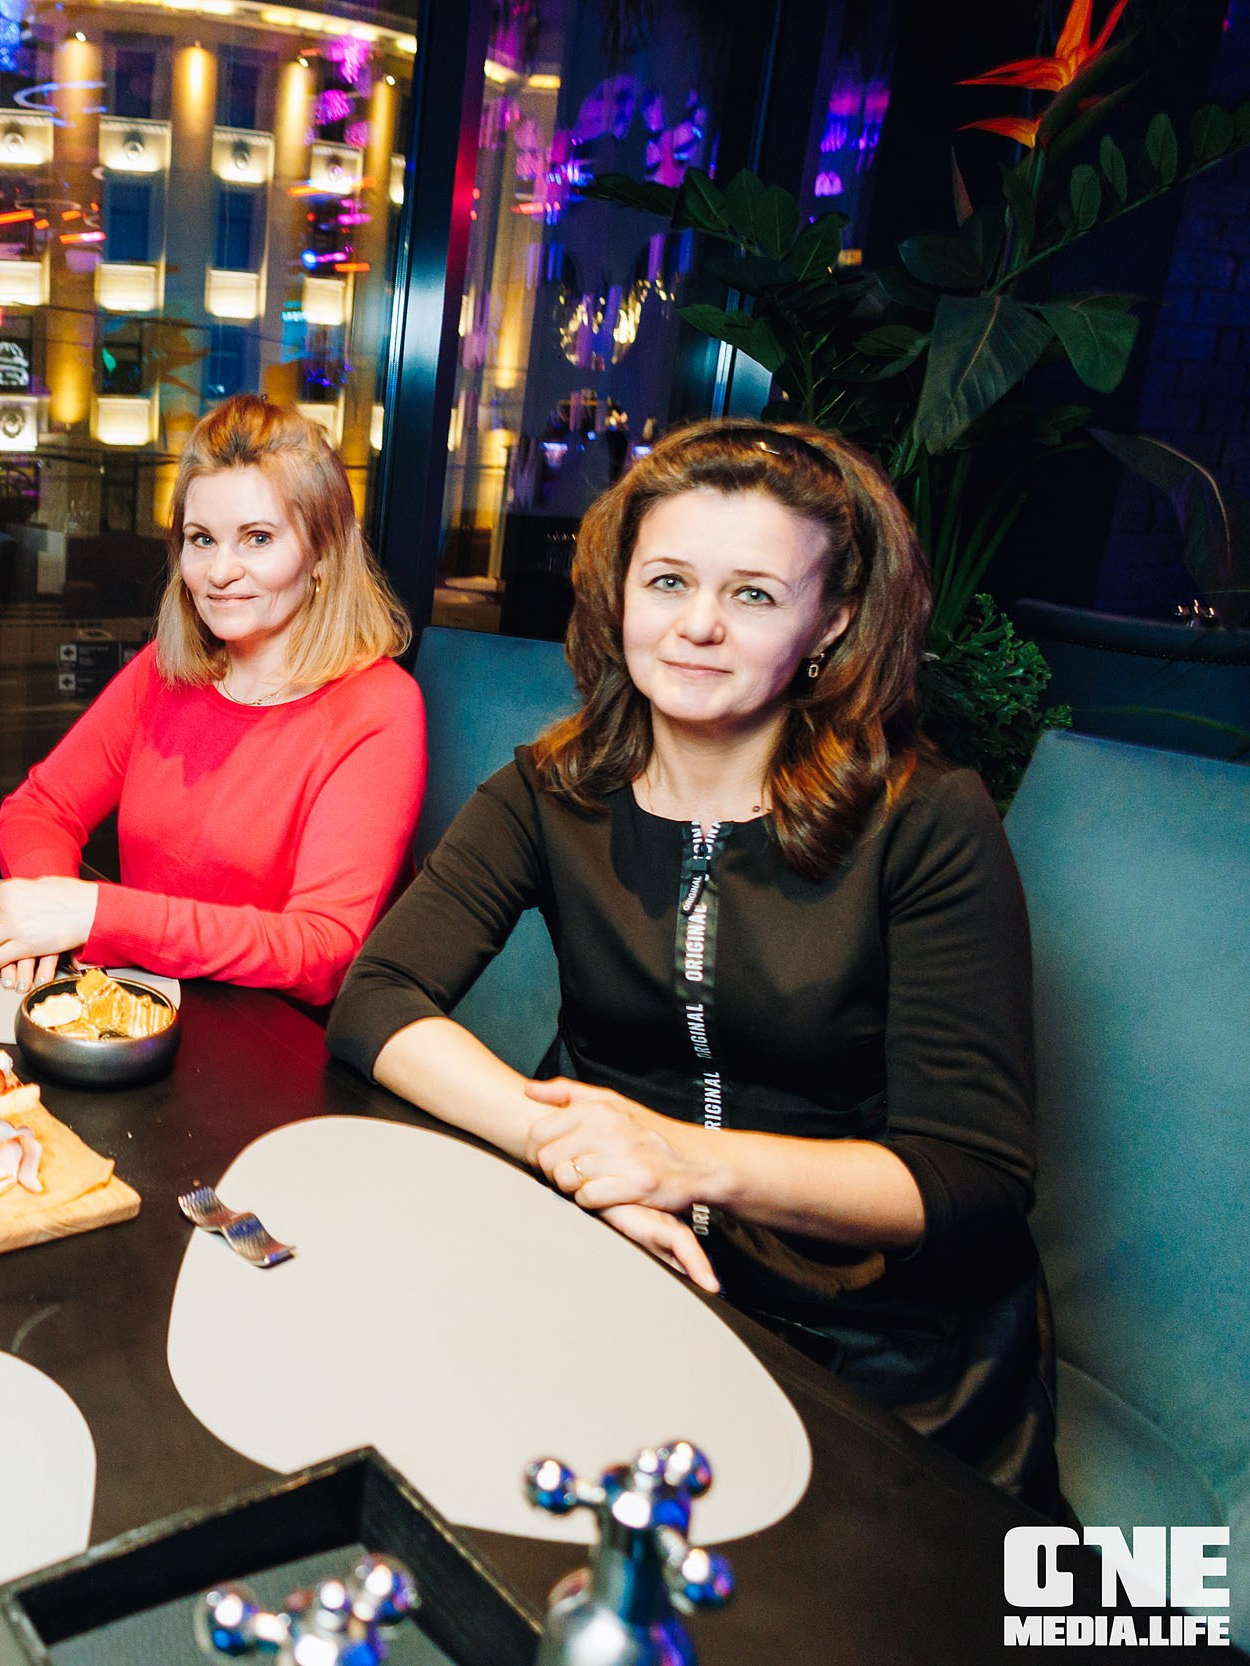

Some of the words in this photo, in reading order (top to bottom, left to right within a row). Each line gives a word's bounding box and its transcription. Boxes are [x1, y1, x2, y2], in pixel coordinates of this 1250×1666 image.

[682, 875, 703, 912] ORIGINAL
[685, 903, 708, 982] ORIGINAL
[686, 1003, 712, 1059] ORIGINAL
[703, 1071, 722, 1131] RIGINAL
